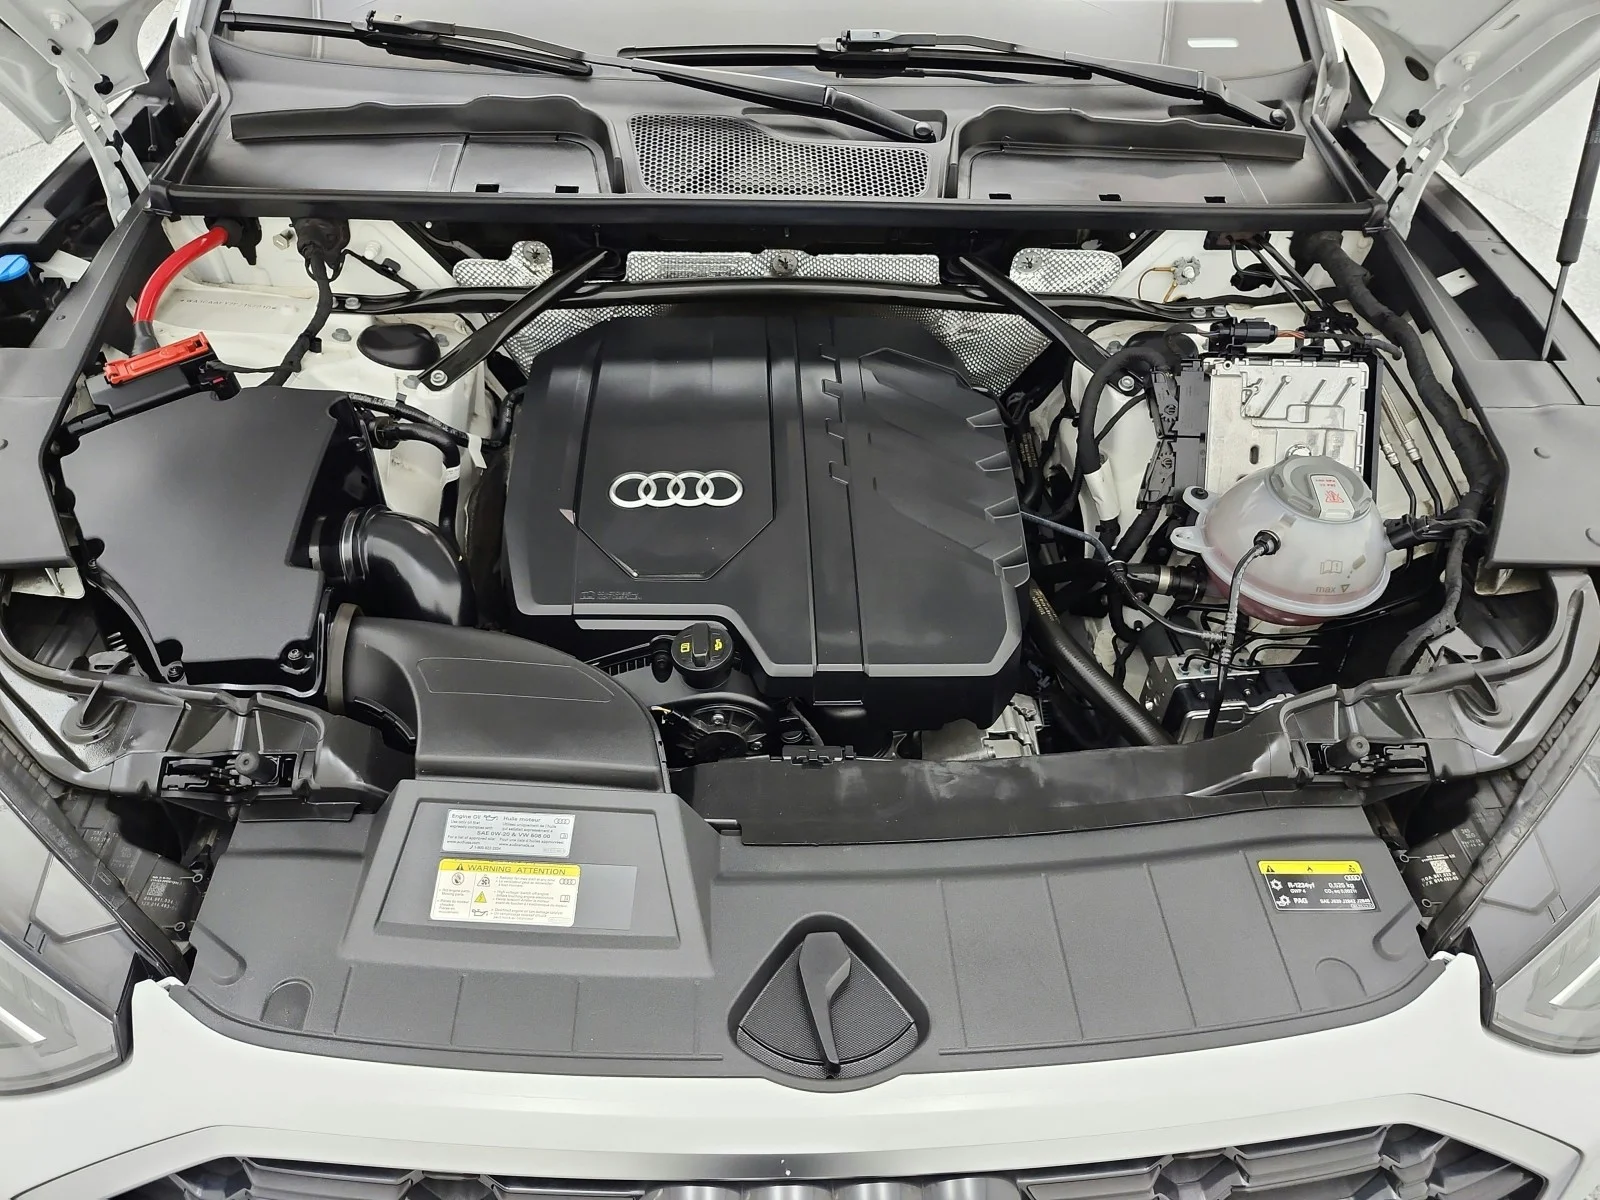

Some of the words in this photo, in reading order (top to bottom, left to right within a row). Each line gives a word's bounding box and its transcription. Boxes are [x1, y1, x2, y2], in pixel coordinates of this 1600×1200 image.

[1315, 584, 1336, 593] max
[467, 864, 512, 873] WARNING
[515, 867, 567, 876] ATTENTION
[1345, 881, 1356, 890] kg
